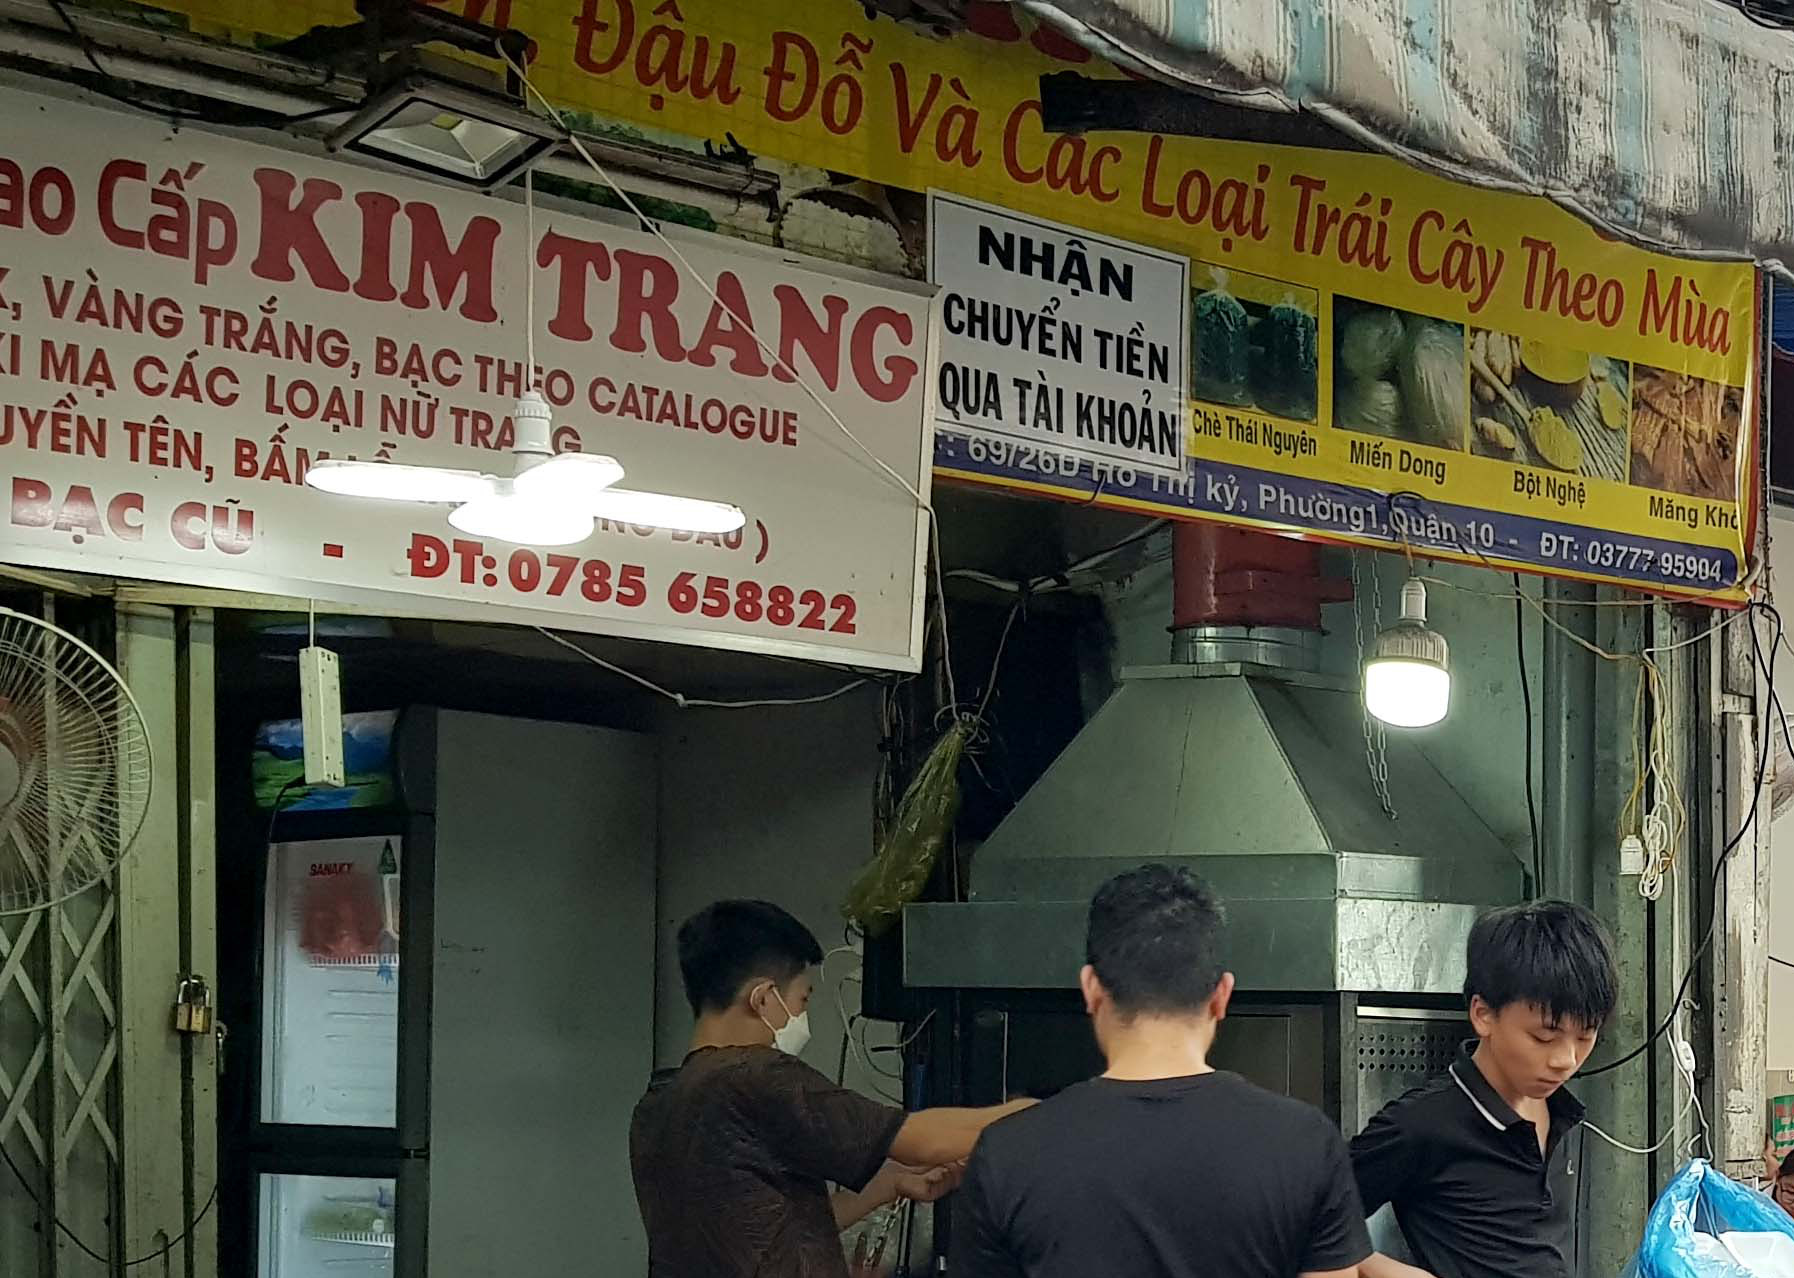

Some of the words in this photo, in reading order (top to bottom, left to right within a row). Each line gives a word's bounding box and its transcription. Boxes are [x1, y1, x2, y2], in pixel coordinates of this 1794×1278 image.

[572, 0, 741, 111] Đậu
[764, 32, 873, 135] Đỗ
[890, 62, 983, 169] Và
[1141, 135, 1273, 252] Loại
[1290, 173, 1394, 271] Trái
[1408, 210, 1504, 313] Cây
[1520, 236, 1623, 328] Theo
[1638, 269, 1732, 357] Mùa
[97, 161, 238, 286] Cấp
[250, 167, 502, 324] KIM
[536, 231, 919, 402] TRANG
[979, 224, 1134, 302] NHẬN
[42, 268, 184, 338] VÀNG
[200, 296, 360, 378] TRẮNG,
[375, 336, 462, 388] BẠC
[589, 376, 798, 447] CATALOGUE
[943, 292, 1083, 364] CHUYỂN
[1094, 321, 1169, 384] TIỀN
[41, 339, 117, 398] MẠ
[133, 349, 240, 407] CÁC
[265, 375, 363, 433] LOẠI
[450, 406, 581, 455] TRAG
[939, 361, 1003, 421] QUA
[1013, 369, 1064, 434] TÀI
[1075, 388, 1178, 458] KHOẢN
[1192, 409, 1222, 438] Chè
[1226, 417, 1258, 445] Thái
[1262, 423, 1317, 459] Nguyên
[124, 415, 214, 483] TÊN,
[1349, 439, 1392, 470] Miến
[1399, 449, 1446, 486] Dong
[1513, 469, 1542, 499] Bột
[1545, 476, 1586, 510] Nghệ
[1466, 520, 1495, 548] 10
[1540, 532, 1580, 562] ĐT:
[1587, 540, 1654, 571] 03777
[1661, 552, 1722, 582] 95904
[1649, 495, 1698, 529] Măng
[12, 476, 144, 544] BẠC
[171, 498, 255, 555] CŨ
[667, 571, 857, 635] 658822
